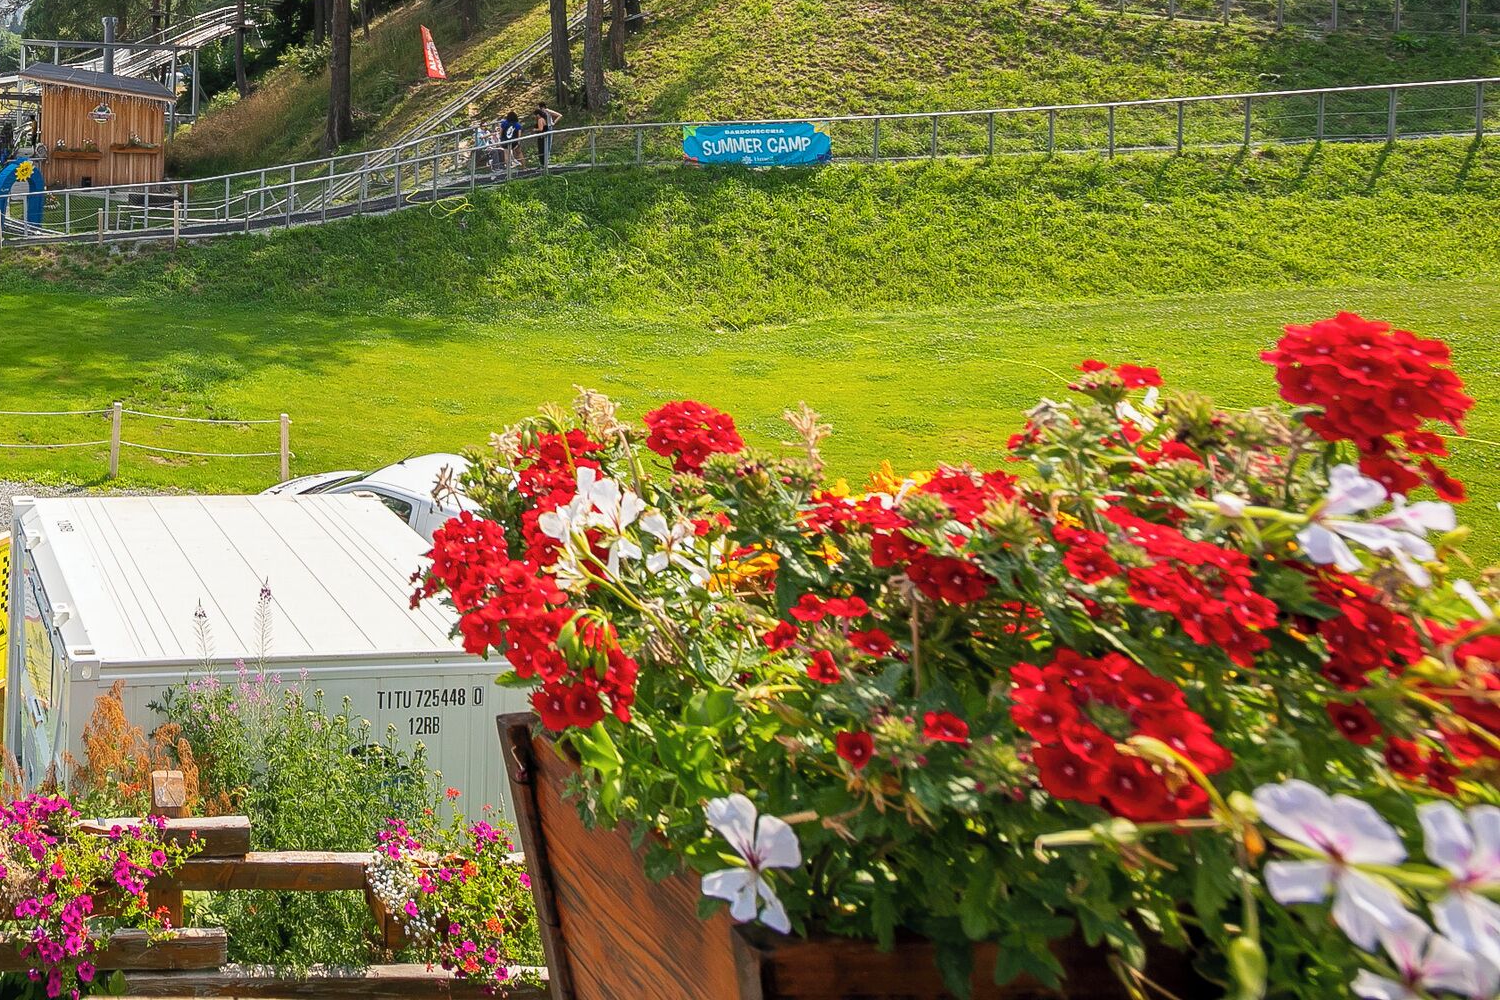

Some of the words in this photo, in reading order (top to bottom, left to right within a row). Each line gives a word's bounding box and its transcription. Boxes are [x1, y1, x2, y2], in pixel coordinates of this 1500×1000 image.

[702, 137, 762, 156] SUMMER
[767, 135, 811, 153] CAMP
[377, 690, 412, 710] TITU
[415, 688, 466, 708] 725448
[473, 686, 483, 706] 0
[408, 716, 440, 736] 12RB
